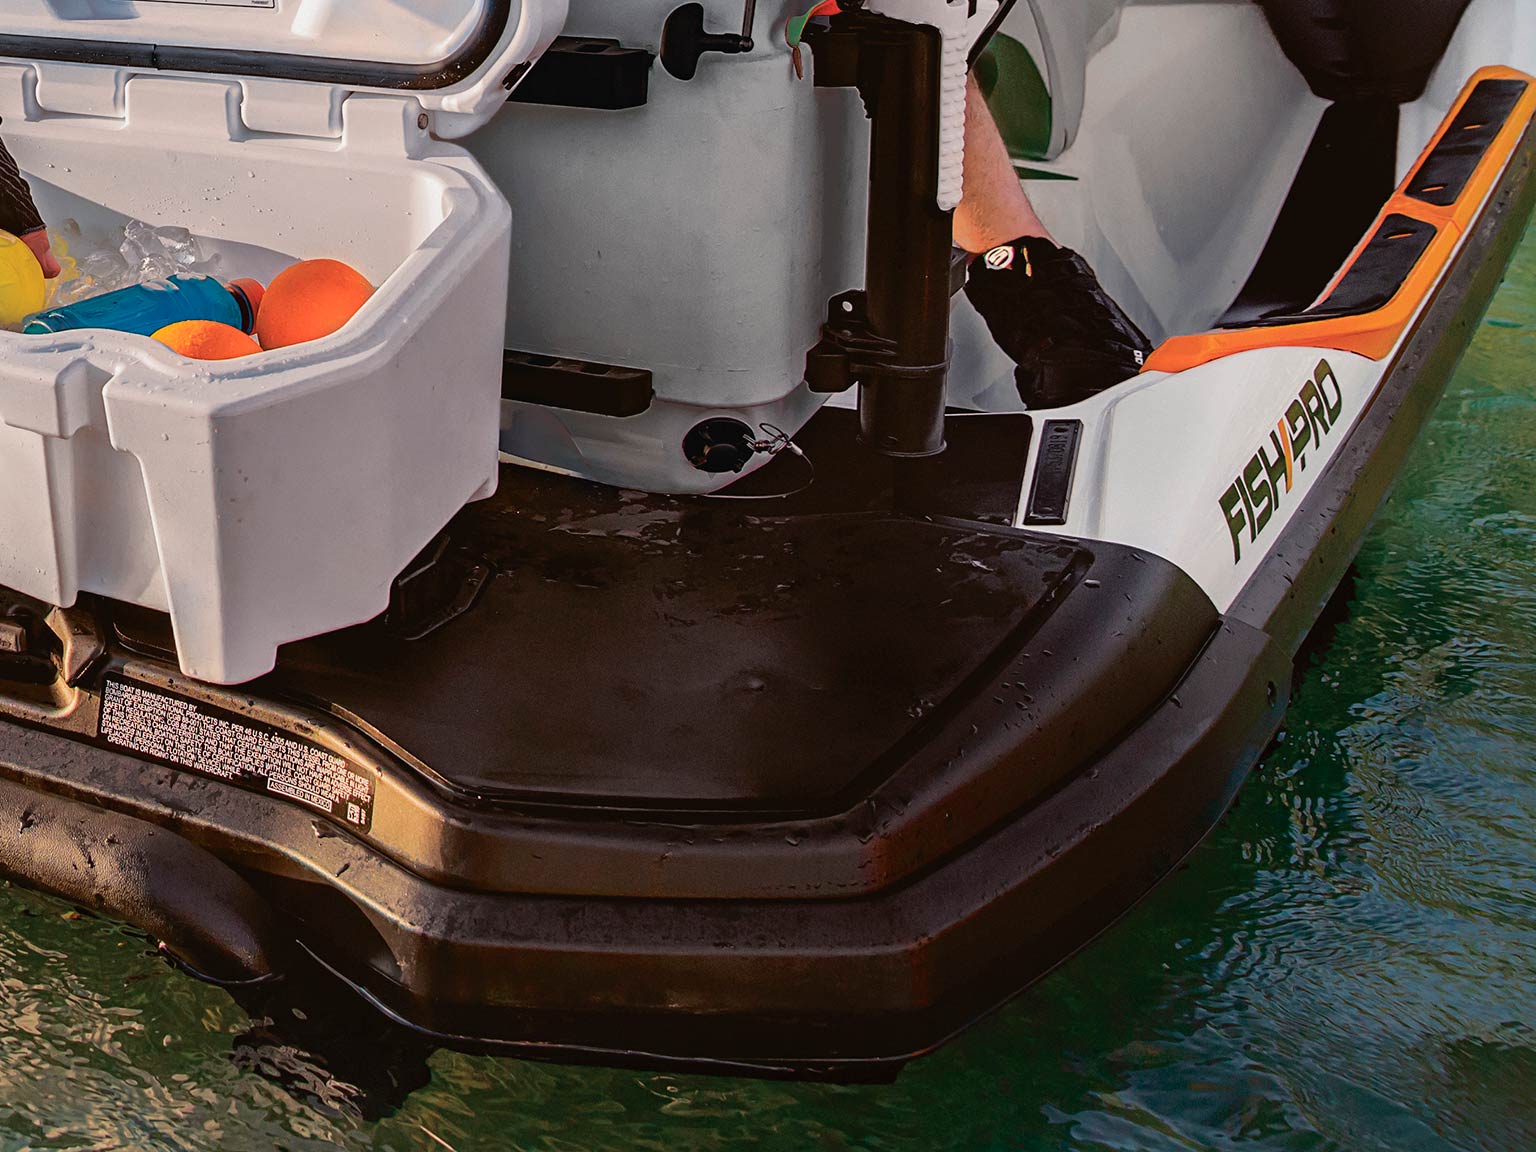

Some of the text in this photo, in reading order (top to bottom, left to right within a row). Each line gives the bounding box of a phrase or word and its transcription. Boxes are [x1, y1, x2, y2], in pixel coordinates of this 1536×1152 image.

[106, 687, 142, 703] BOMBARDIER
[143, 698, 184, 714] RECREATIONAL
[186, 710, 218, 725] PRODUCTS
[231, 724, 244, 733] PER
[285, 739, 297, 748] AND
[310, 748, 328, 759] COAST
[328, 755, 345, 768] GUARD
[107, 680, 119, 690] THIS
[120, 684, 135, 694] BOAT
[142, 690, 188, 709] MANUFACTURED
[101, 727, 112, 735] LIFE
[113, 729, 133, 741] JACKET
[166, 746, 197, 761] FLOTATION
[222, 763, 241, 776] WHILE
[102, 720, 135, 735] STANDARDS
[142, 732, 164, 744] EFFECT
[175, 741, 186, 750] THE
[187, 746, 202, 755] DATE
[257, 766, 268, 776] ALL
[269, 771, 297, 786] PERSONS
[298, 781, 320, 794] SHOULD
[321, 789, 335, 801] WEAR
[104, 700, 125, 711] SAFETY
[199, 728, 220, 740] STATES
[222, 735, 236, 743] THAT
[237, 739, 262, 752] CERTAIN
[263, 747, 304, 765] REGULATIONS
[304, 761, 315, 770] ARE
[316, 766, 348, 783] INAPPLICABLE
[105, 694, 369, 786] GRANT OF EXEMPTION THE COAST GUARD EXEMPTS THIS VESSEL FROM ONE OR MORE
[107, 734, 139, 750] OPERATING
[140, 745, 148, 753] OR
[149, 747, 169, 759] RIDING
[170, 753, 179, 762] ON
[180, 756, 192, 767] THIS
[112, 716, 153, 735] RECREATIONAL
[154, 728, 179, 740] BOATING
[204, 745, 217, 754] THIS
[218, 748, 233, 758] BOAT
[234, 753, 264, 768] COMPLIES
[265, 762, 280, 773] WITH
[294, 771, 313, 783] COAST
[313, 779, 331, 791] GUARD
[113, 709, 124, 718] THIS
[152, 722, 204, 742] CHARACTERISTICS
[205, 737, 218, 747] AND
[219, 741, 233, 750] THAT
[235, 745, 246, 755] THE
[247, 750, 281, 765] EXEMPTION
[282, 760, 296, 771] WILL
[296, 764, 309, 774] NOT
[309, 770, 323, 781] HAVE
[324, 776, 331, 784] AN
[353, 789, 371, 803] EFFECT
[270, 781, 303, 798] ASSEMBLED
[310, 795, 330, 810] MEXICO
